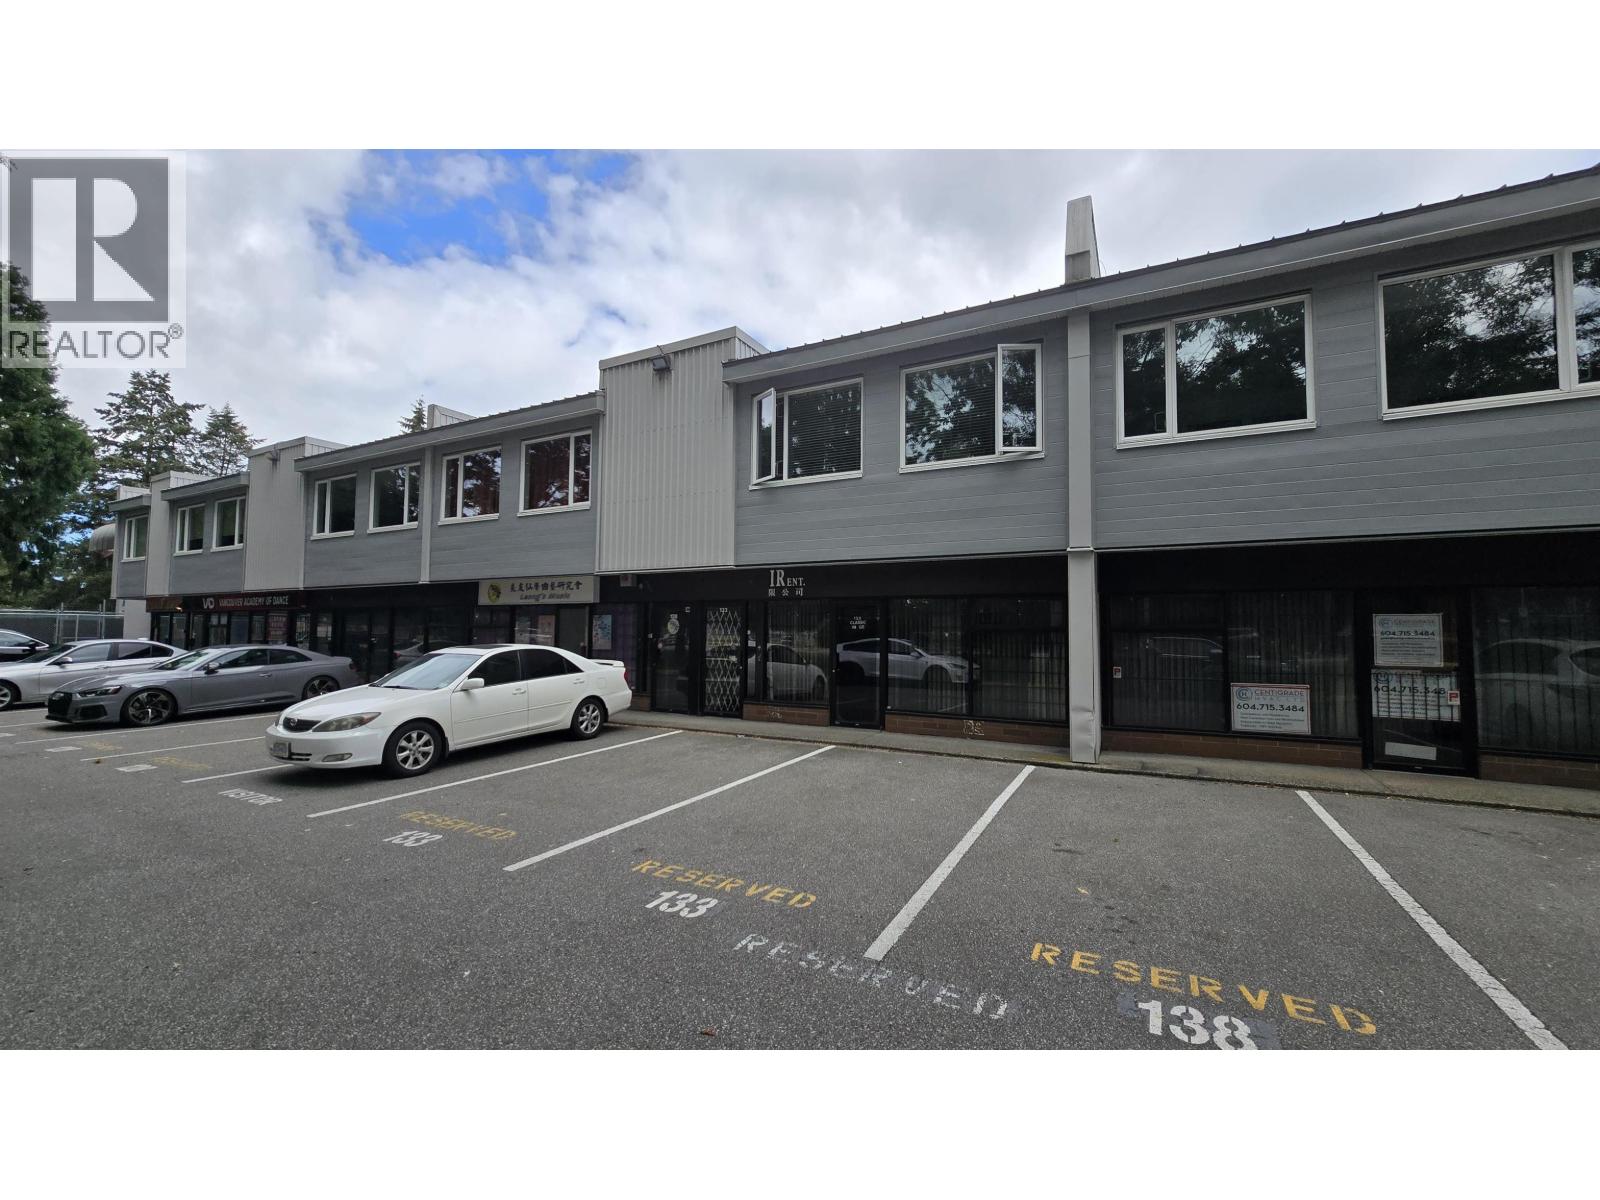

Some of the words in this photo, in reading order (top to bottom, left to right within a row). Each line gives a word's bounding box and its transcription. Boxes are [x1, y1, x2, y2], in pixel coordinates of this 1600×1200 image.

[266, 597, 272, 605] OF
[272, 596, 289, 605] DANCE
[1254, 689, 1305, 697] CENTIGRADE
[1374, 685, 1447, 695] 604.715.348
[1236, 703, 1305, 713] 604.715.3484
[631, 859, 818, 908] RESERVED
[644, 890, 719, 918] 133
[1031, 942, 1377, 1036] RESERVED
[1138, 1000, 1257, 1050] 138
